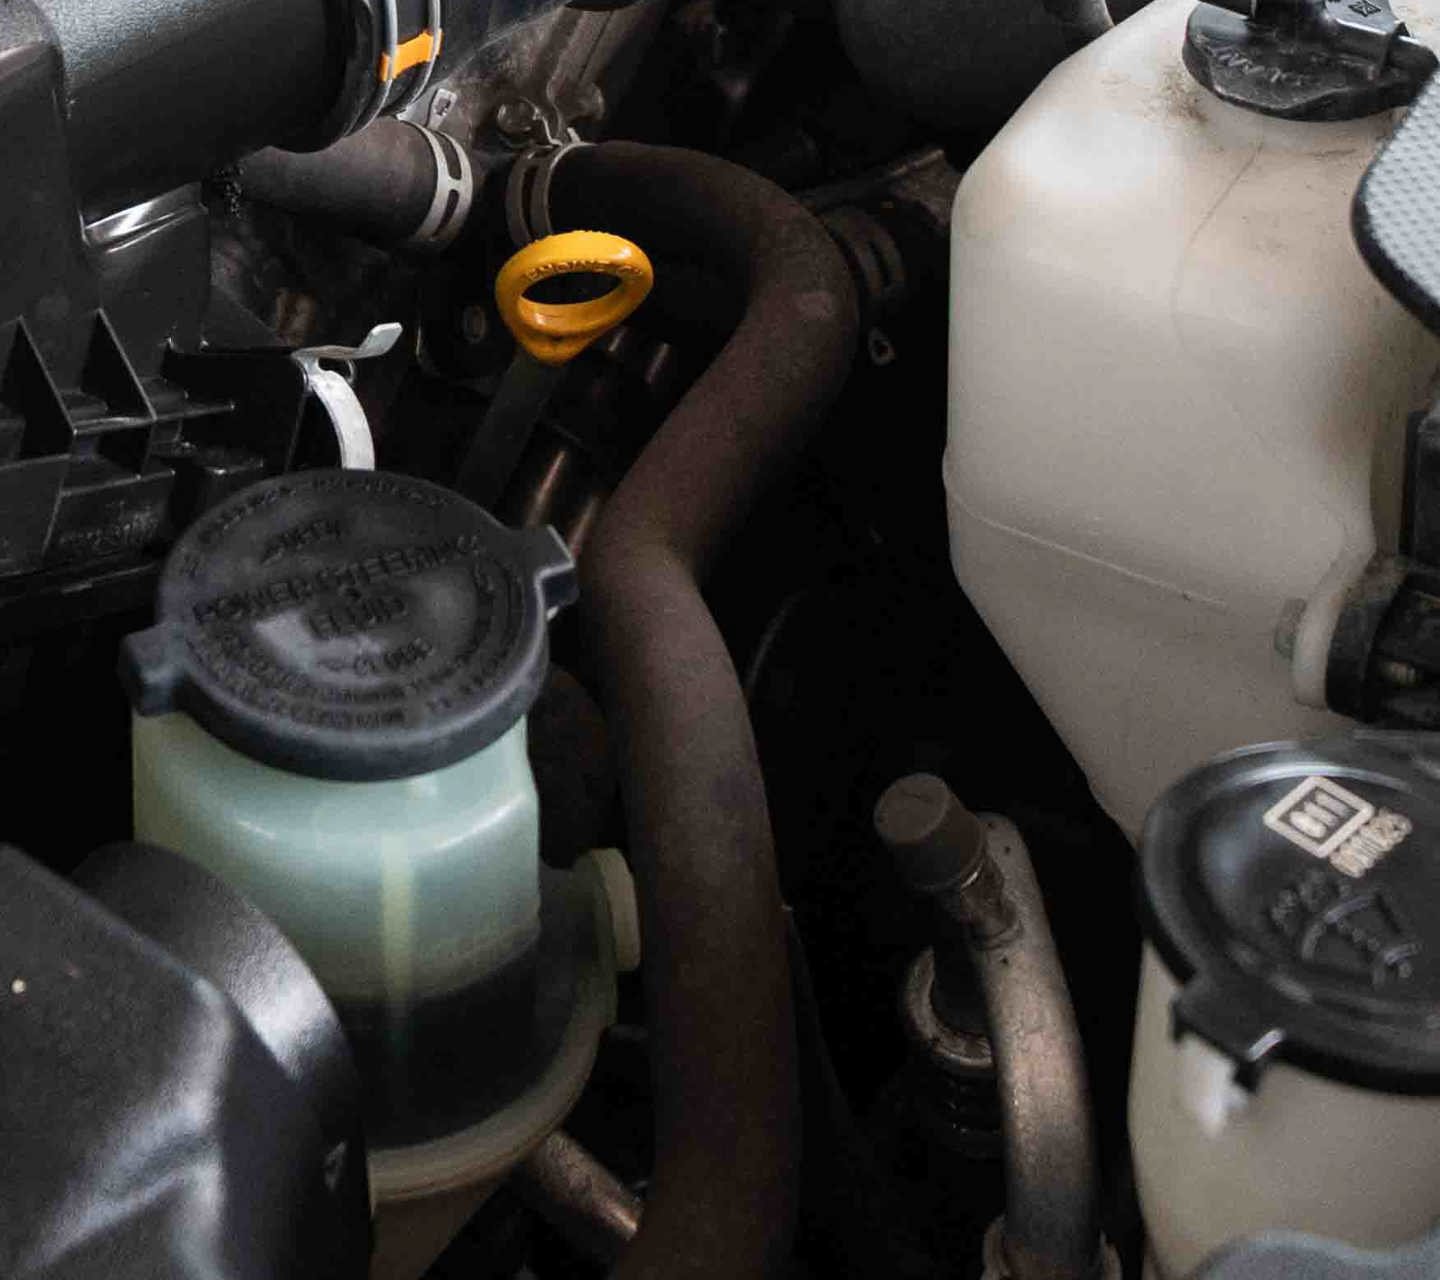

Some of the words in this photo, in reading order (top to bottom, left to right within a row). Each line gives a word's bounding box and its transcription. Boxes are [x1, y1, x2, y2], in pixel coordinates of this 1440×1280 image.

[191, 577, 314, 624] POWER
[316, 534, 481, 590] STEERING
[306, 595, 408, 640] FLUID
